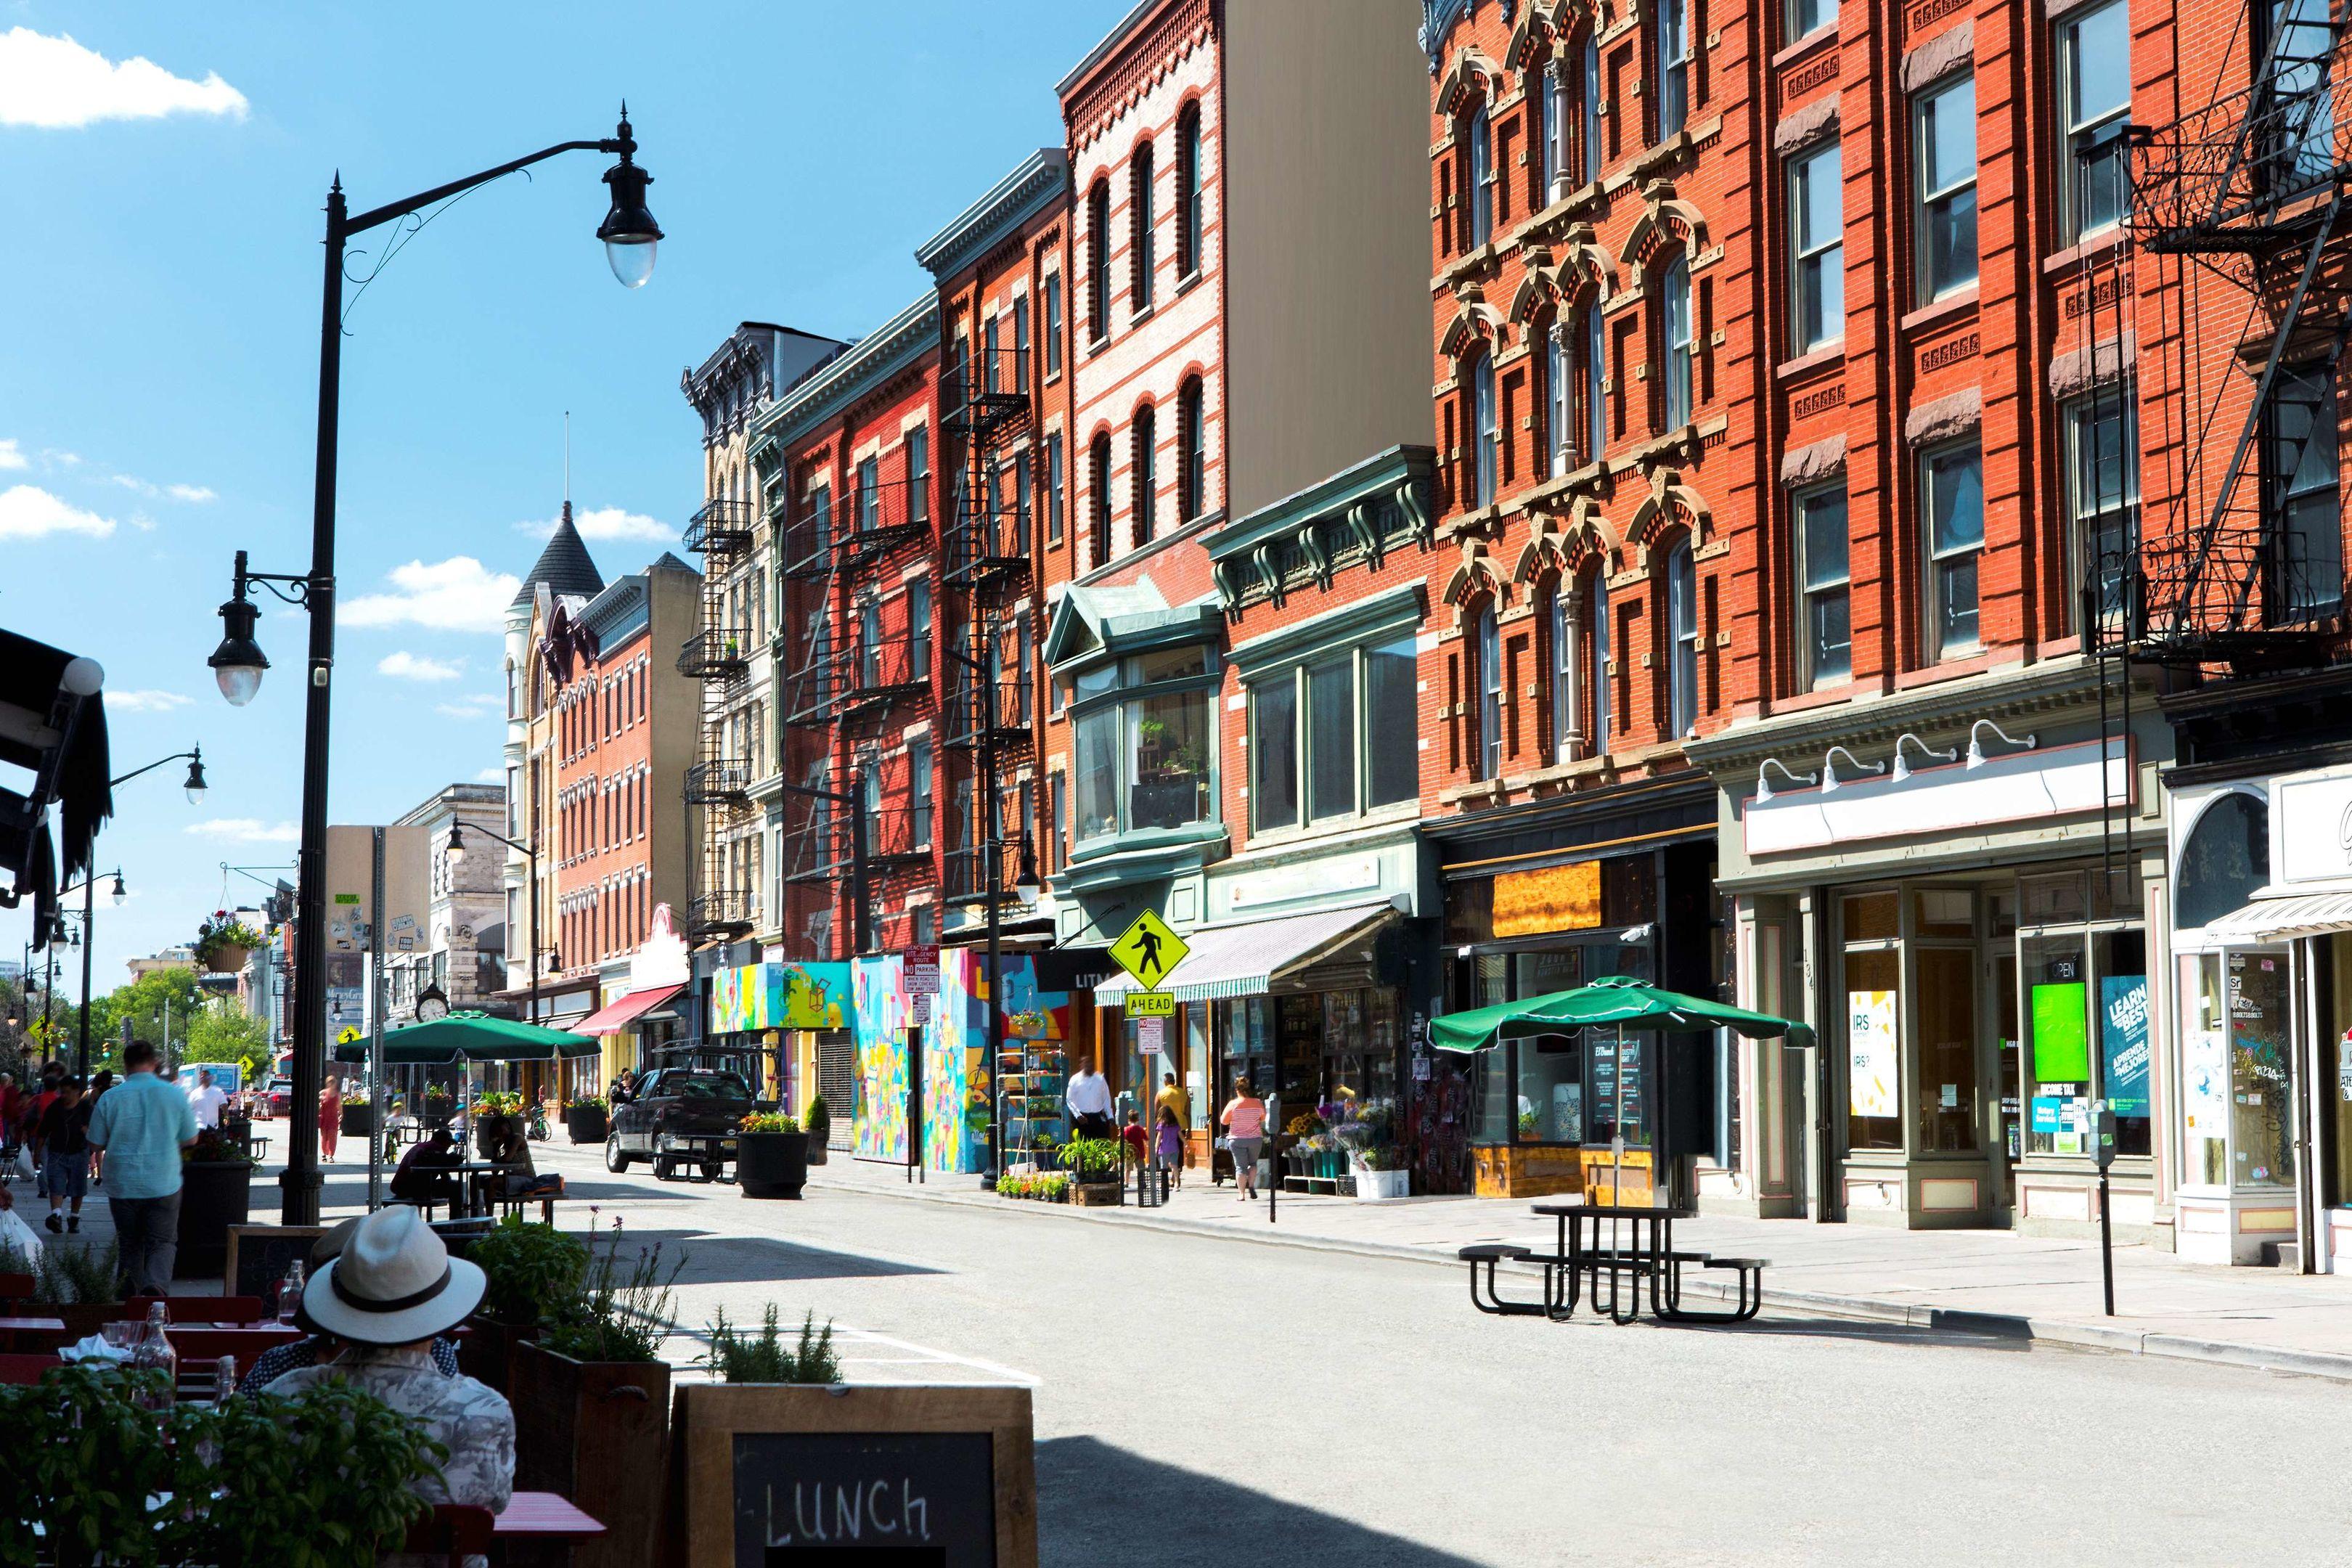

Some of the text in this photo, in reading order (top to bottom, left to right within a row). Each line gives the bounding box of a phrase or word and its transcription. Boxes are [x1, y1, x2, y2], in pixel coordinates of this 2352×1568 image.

[905, 965, 914, 974] NO
[2231, 978, 2240, 988] Sr
[1131, 998, 1170, 1010] AHEAD
[2109, 984, 2147, 1022] LEARN
[2121, 999, 2149, 1032] BEST
[1853, 1015, 1869, 1030] IRS
[2113, 1040, 2146, 1069] APRENDE
[1853, 1055, 1870, 1068] IRS?
[2063, 1083, 2075, 1095] TAX
